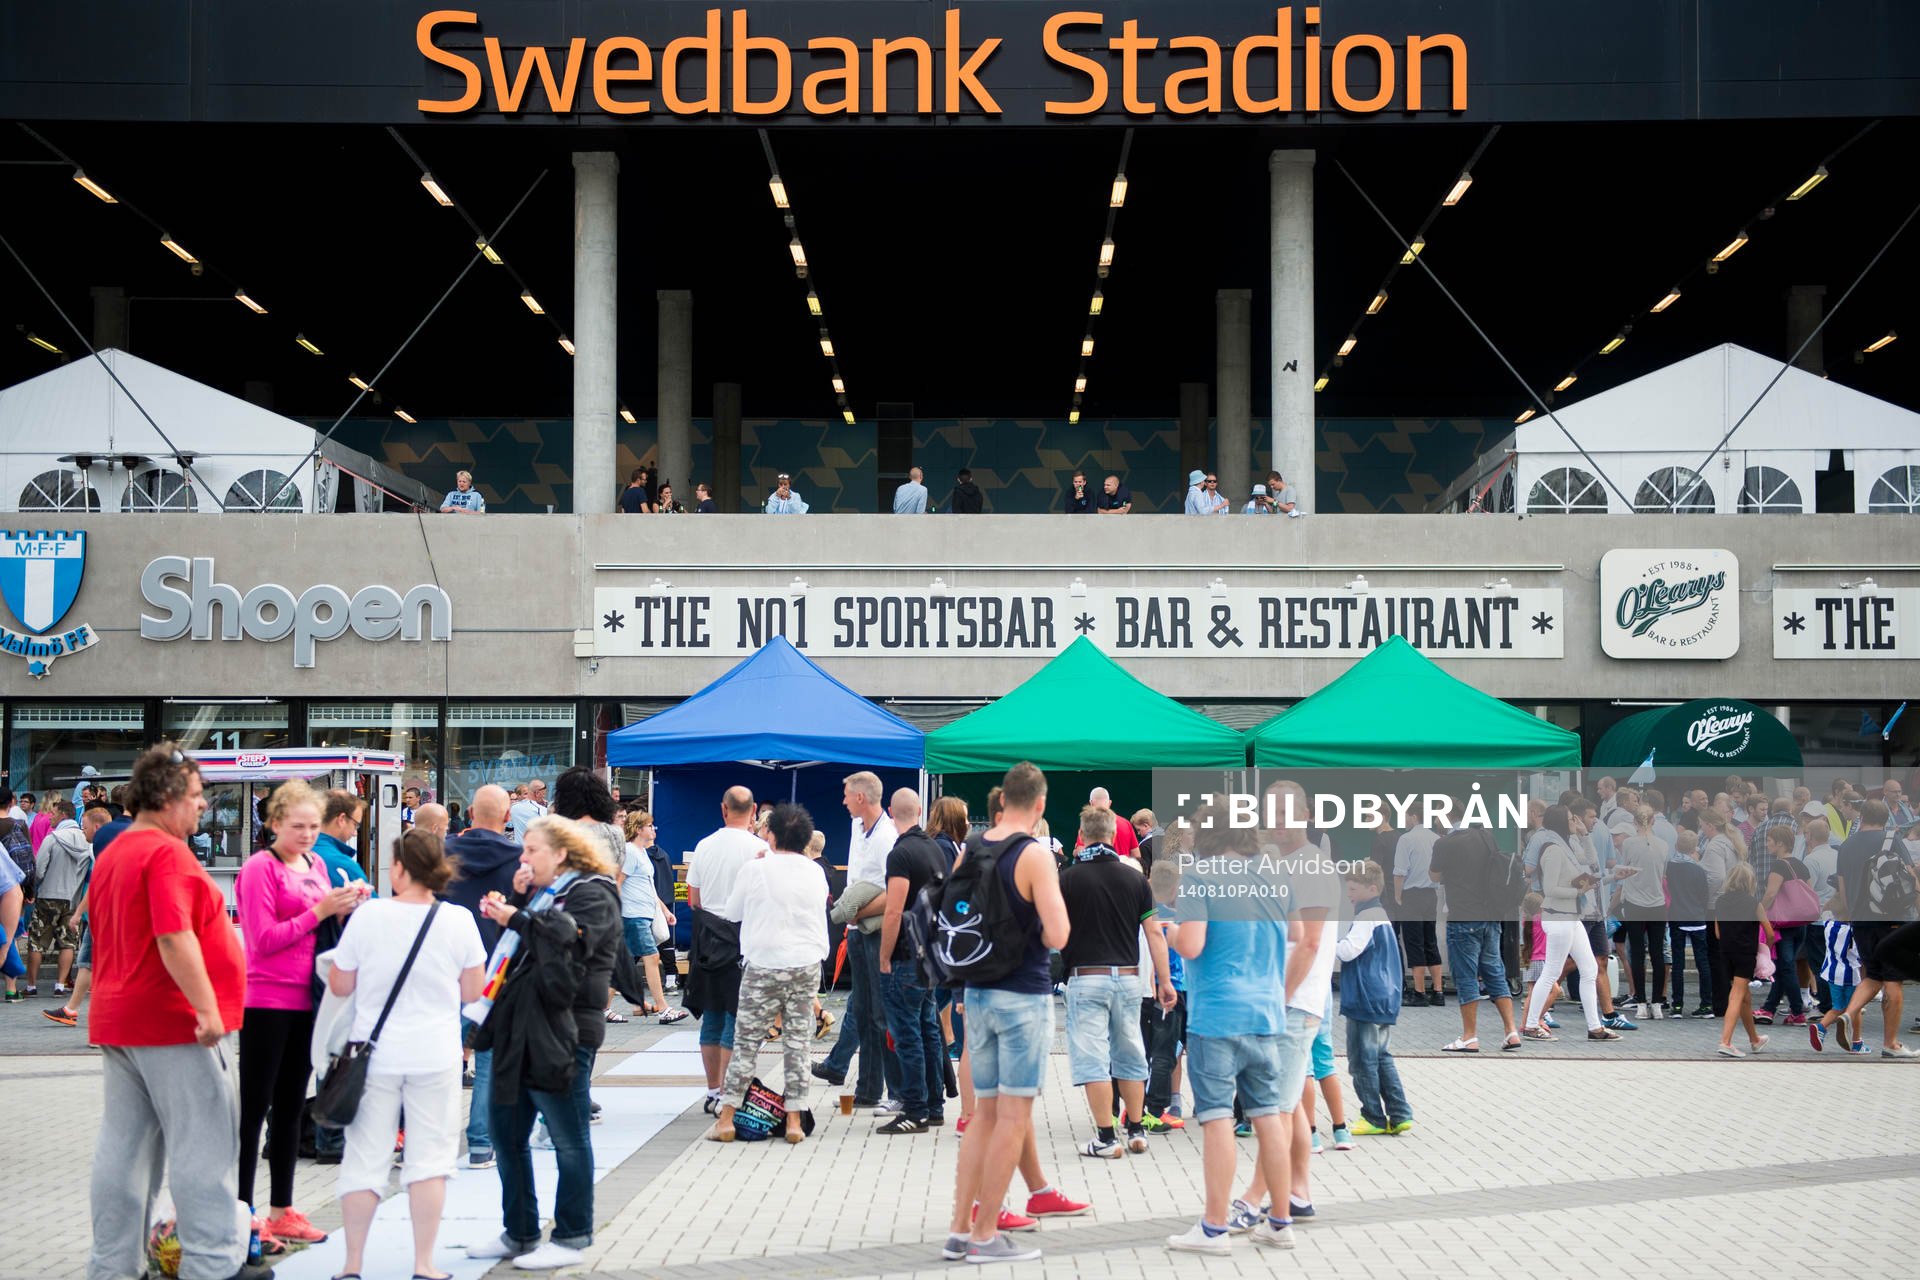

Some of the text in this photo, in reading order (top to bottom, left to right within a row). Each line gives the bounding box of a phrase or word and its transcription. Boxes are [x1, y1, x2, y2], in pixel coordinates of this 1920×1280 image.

[416, 7, 1467, 114] Swedbank Stadion
[1648, 561, 1692, 575] EST 1988
[140, 556, 452, 668] Shopen
[635, 596, 1519, 649] THE NO1 SPORTSBAR BAR & RESTAURANT
[1647, 630, 1667, 645] BAR
[1680, 597, 1720, 647] RESTAURANT
[1815, 596, 1896, 650] THE
[64, 626, 89, 651] FF
[1706, 706, 1718, 715] EST
[1706, 747, 1719, 757] BAR
[1726, 727, 1751, 758] RESTAURANT
